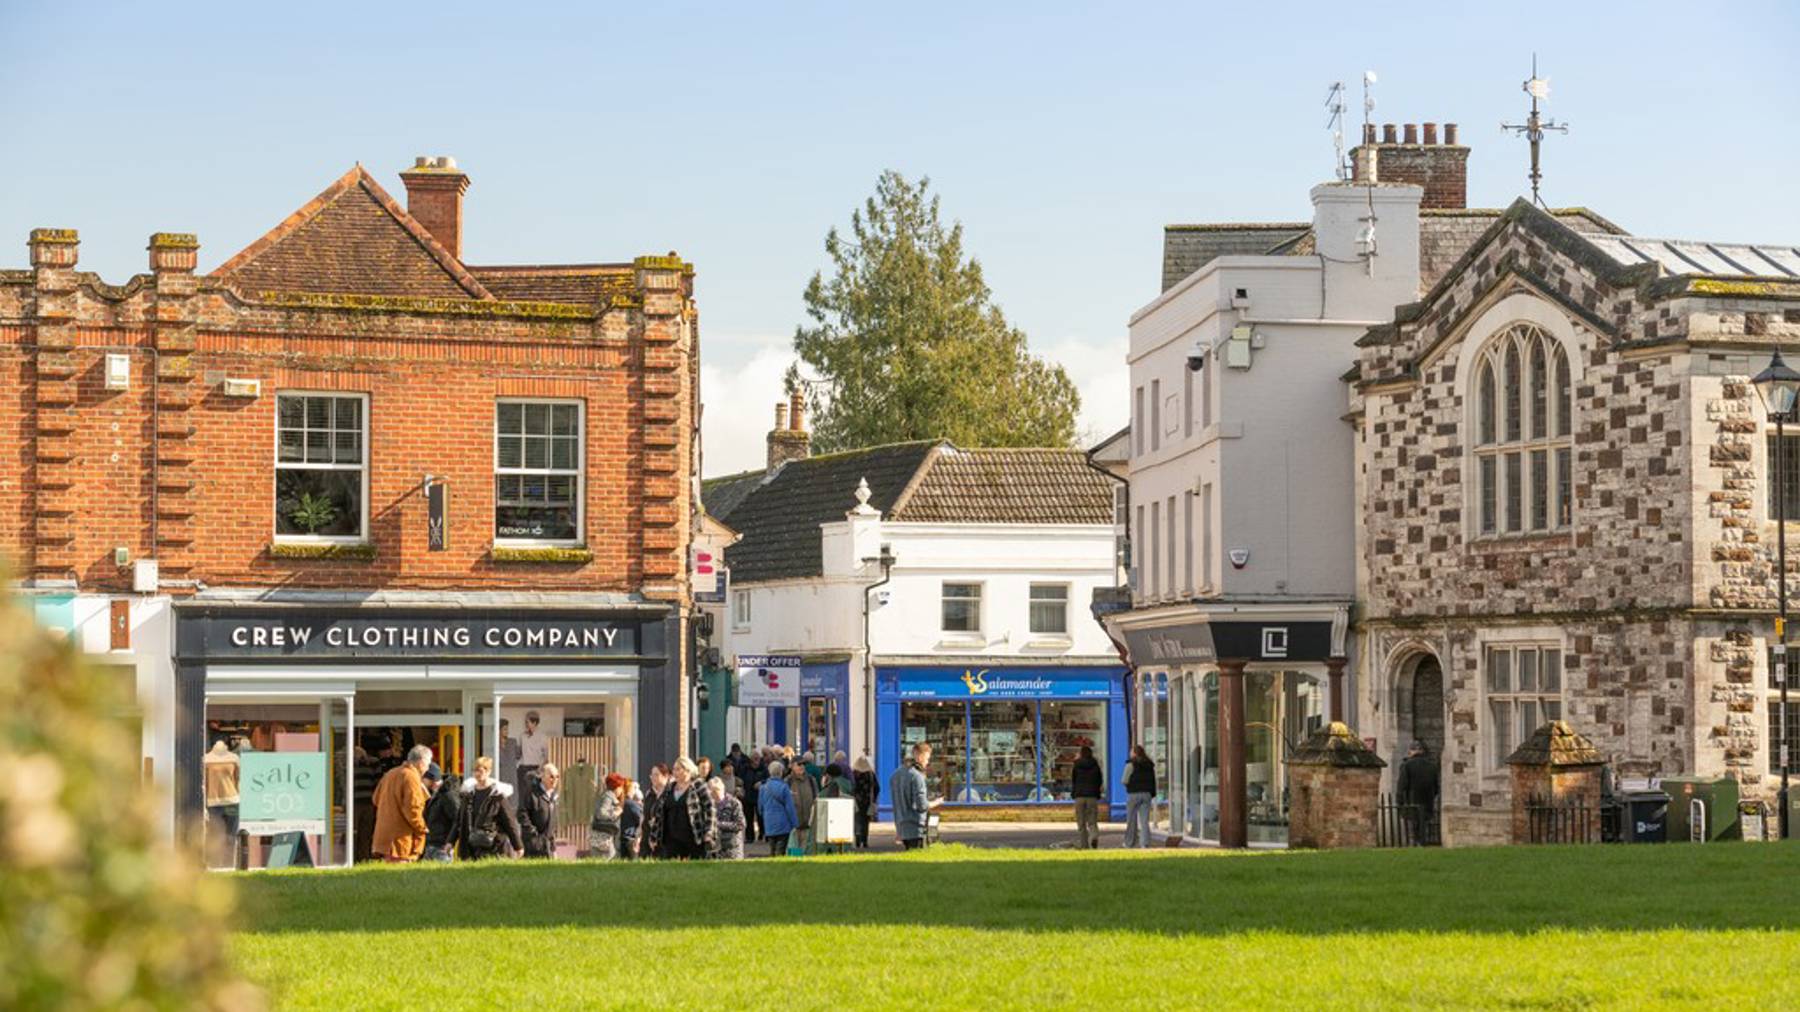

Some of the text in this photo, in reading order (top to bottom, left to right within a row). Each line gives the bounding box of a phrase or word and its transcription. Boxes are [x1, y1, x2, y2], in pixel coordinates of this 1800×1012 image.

[232, 627, 618, 647] CREW CLOTHING COMPANY
[738, 657, 801, 667] UNDER OFFER
[976, 669, 1053, 694] Salamander
[250, 763, 311, 793] sale
